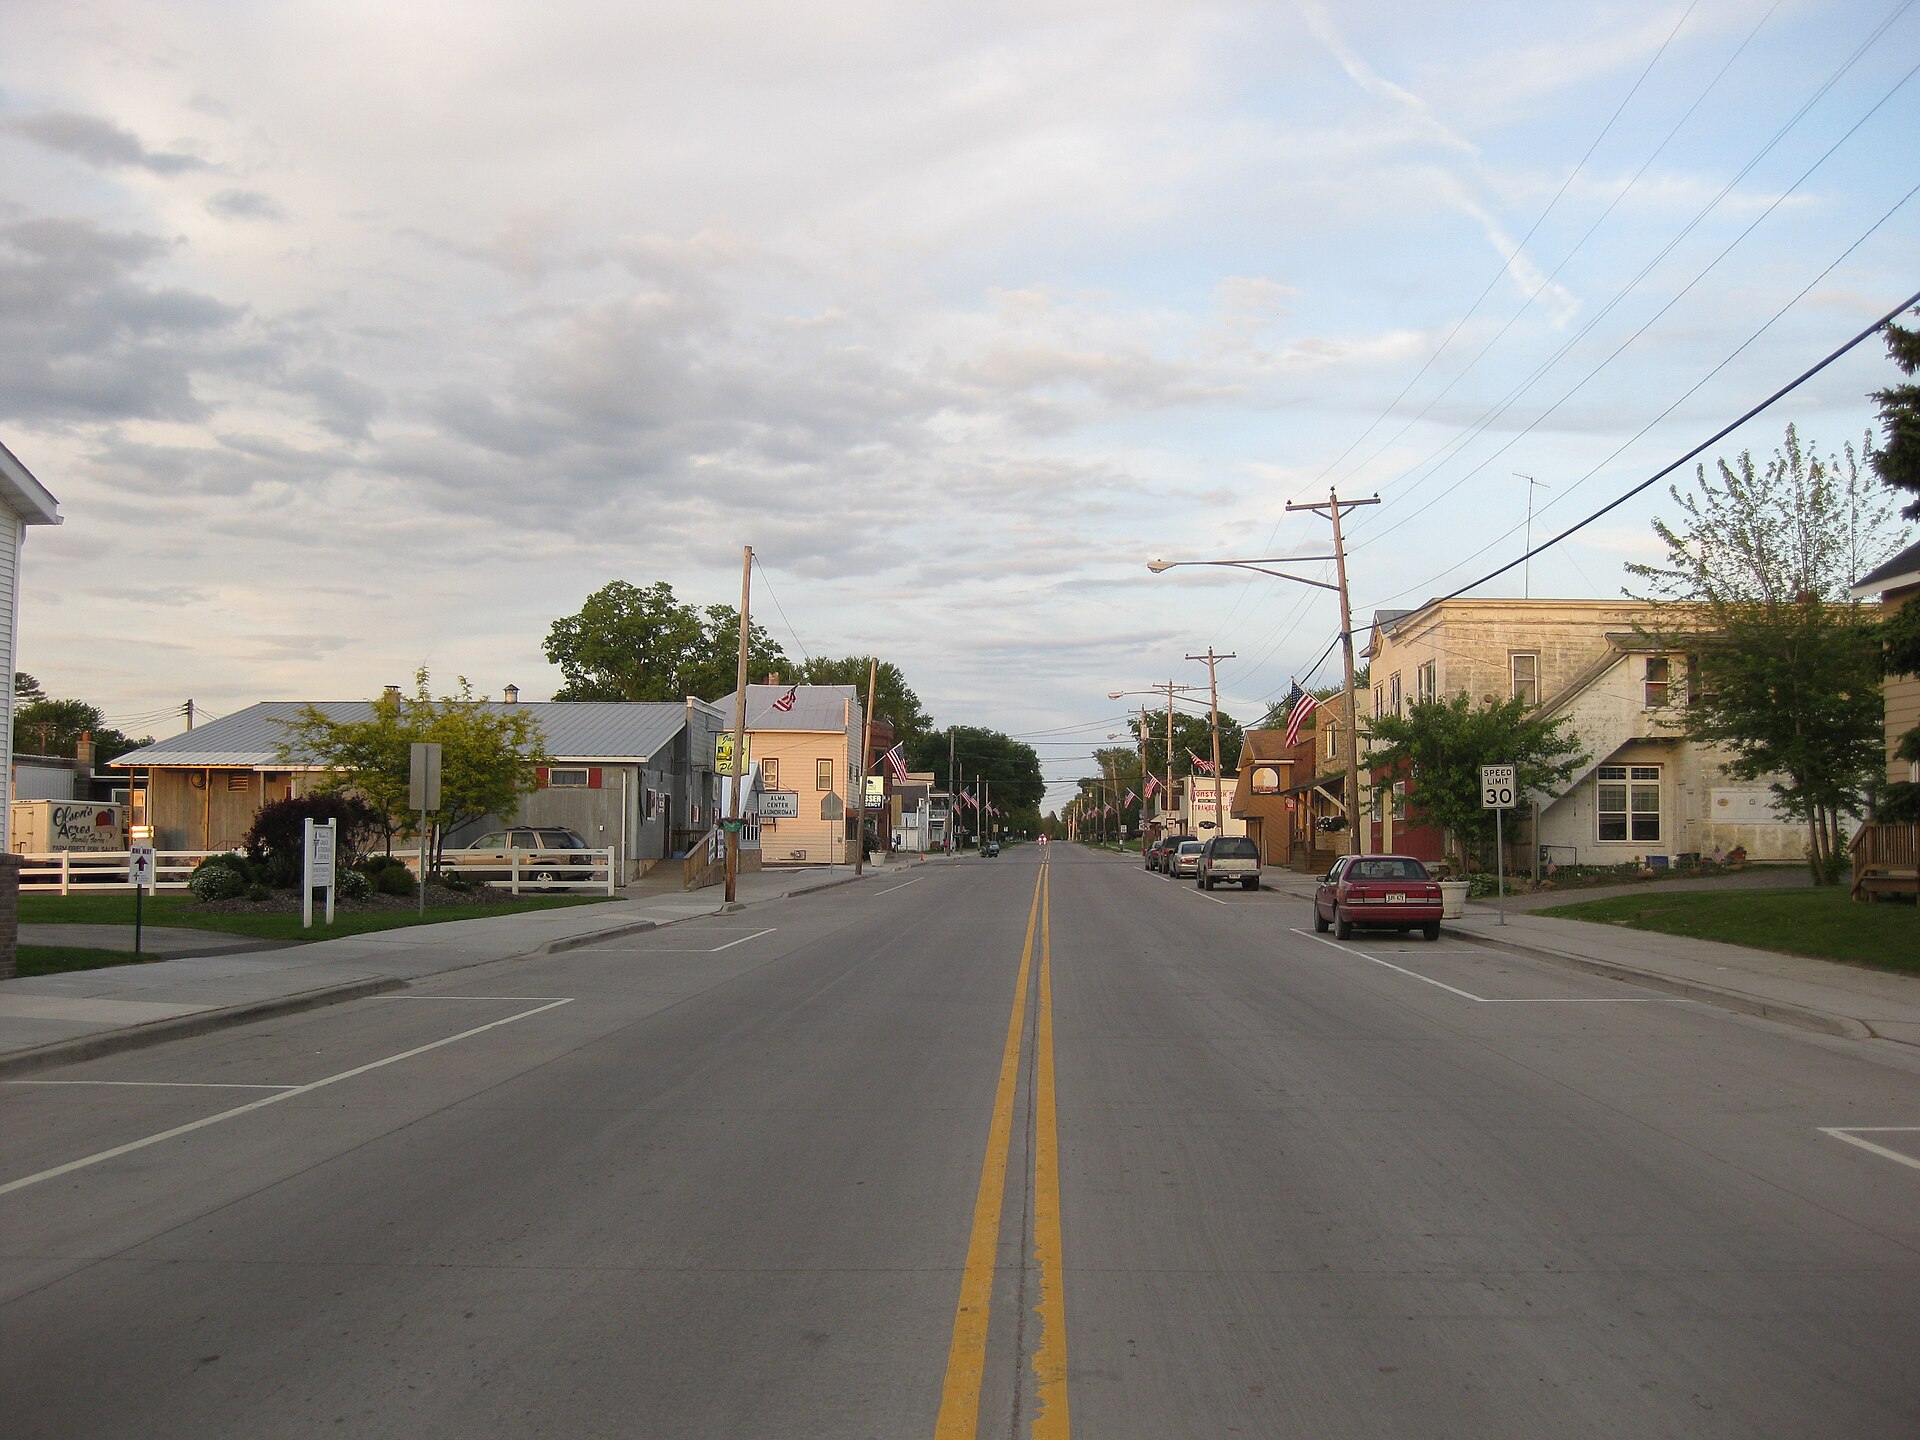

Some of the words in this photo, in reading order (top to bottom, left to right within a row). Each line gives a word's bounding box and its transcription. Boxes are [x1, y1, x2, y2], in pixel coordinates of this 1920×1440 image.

[1486, 788, 1512, 804] 30
[53, 806, 93, 827] Olson's
[57, 823, 91, 840] Acres
